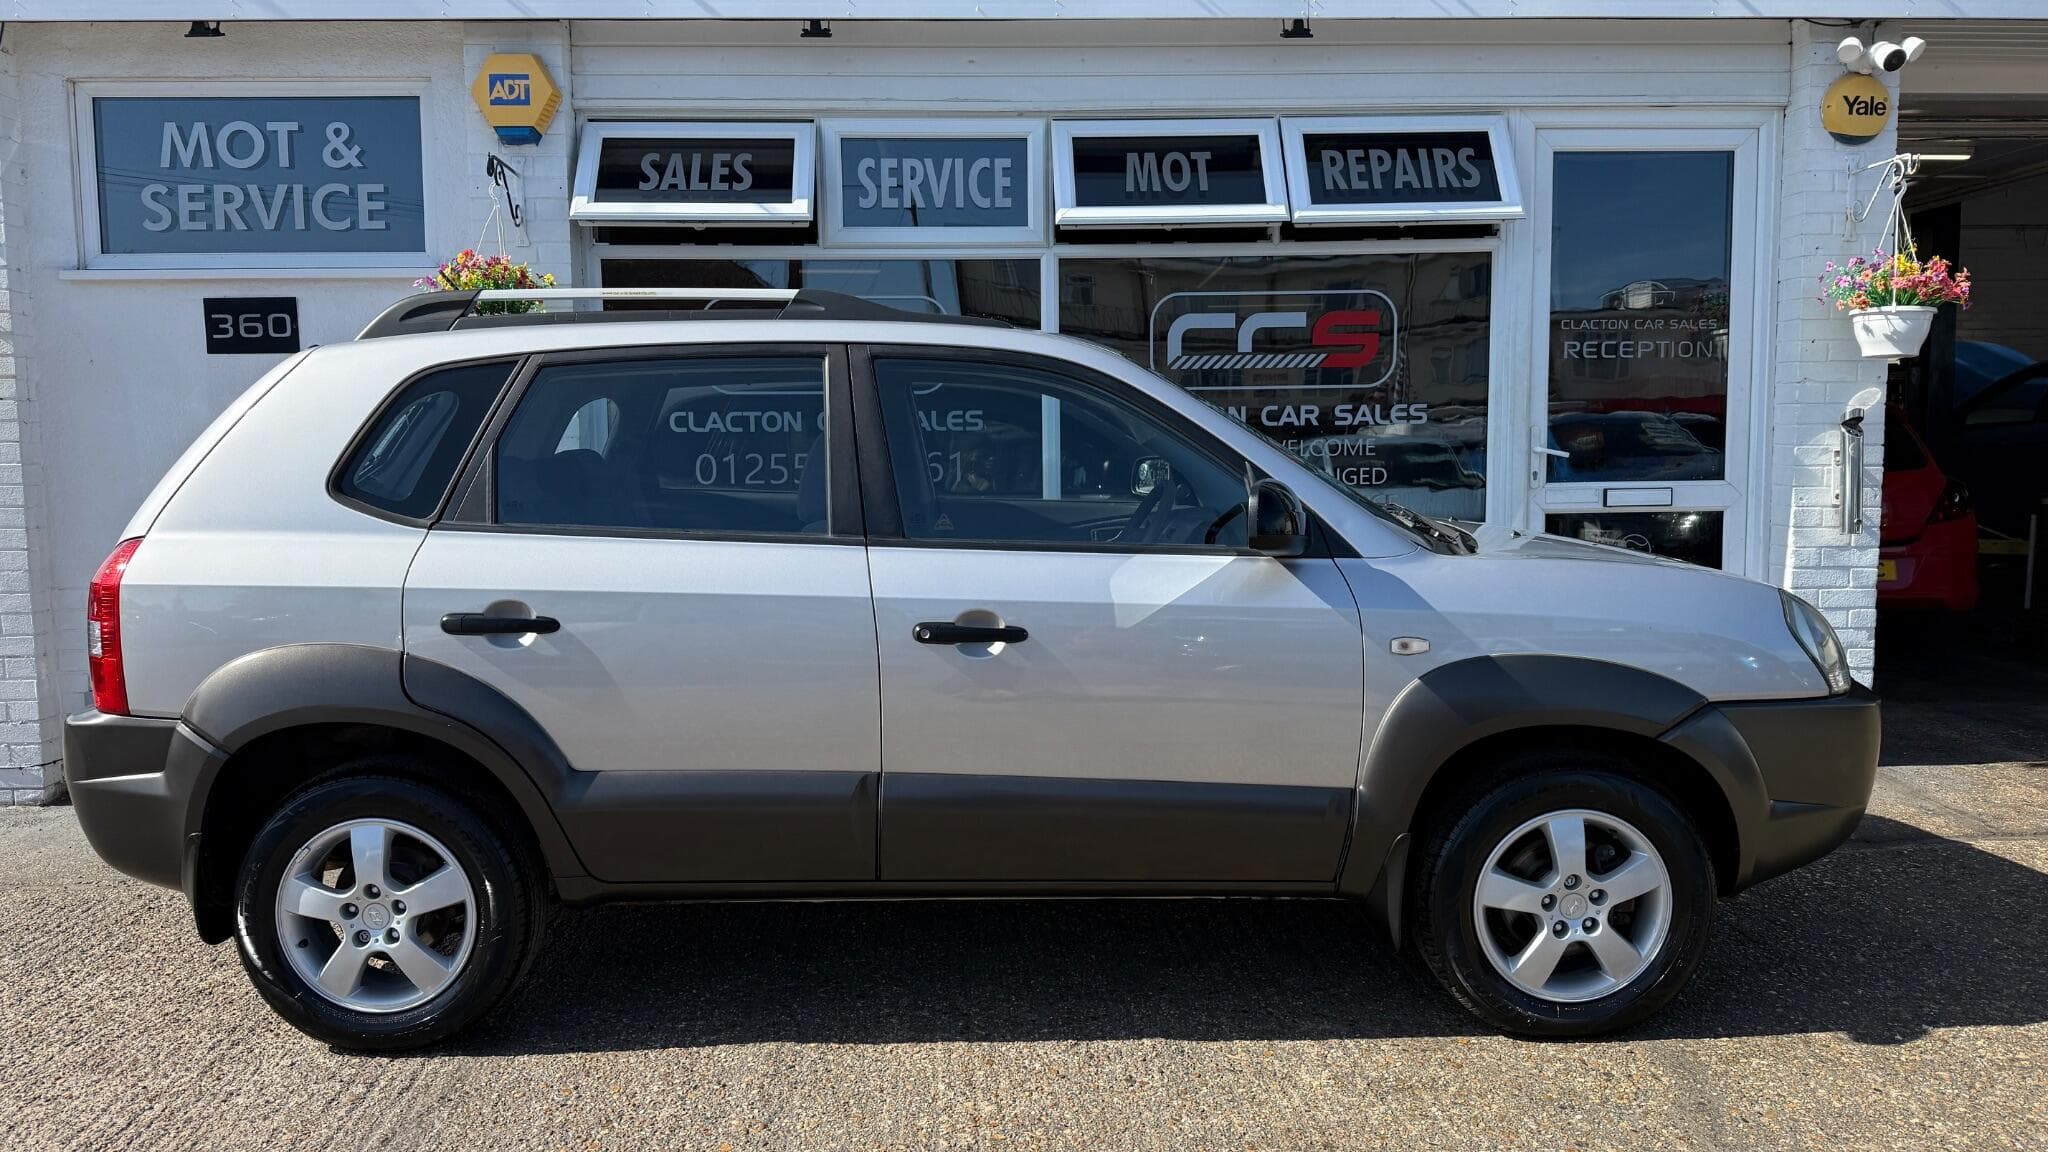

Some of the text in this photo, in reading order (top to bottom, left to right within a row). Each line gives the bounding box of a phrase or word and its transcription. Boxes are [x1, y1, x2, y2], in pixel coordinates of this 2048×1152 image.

[489, 79, 531, 101] ADT
[1843, 95, 1887, 116] Yale
[160, 121, 364, 169] MOT &
[638, 152, 753, 191] SALES
[1125, 151, 1212, 192] MOT
[1321, 147, 1482, 190] REPAIRS
[857, 157, 1012, 209] SERVICE
[141, 183, 389, 232] SERVICE
[211, 312, 292, 339] 360
[1561, 319, 1717, 330] CLACTON CAR SALES
[1563, 340, 1713, 359] RECEPTION
[669, 410, 802, 433] CLACTON
[918, 410, 984, 432] ALES
[1260, 405, 1319, 427] CAR
[1334, 403, 1428, 426] SALES
